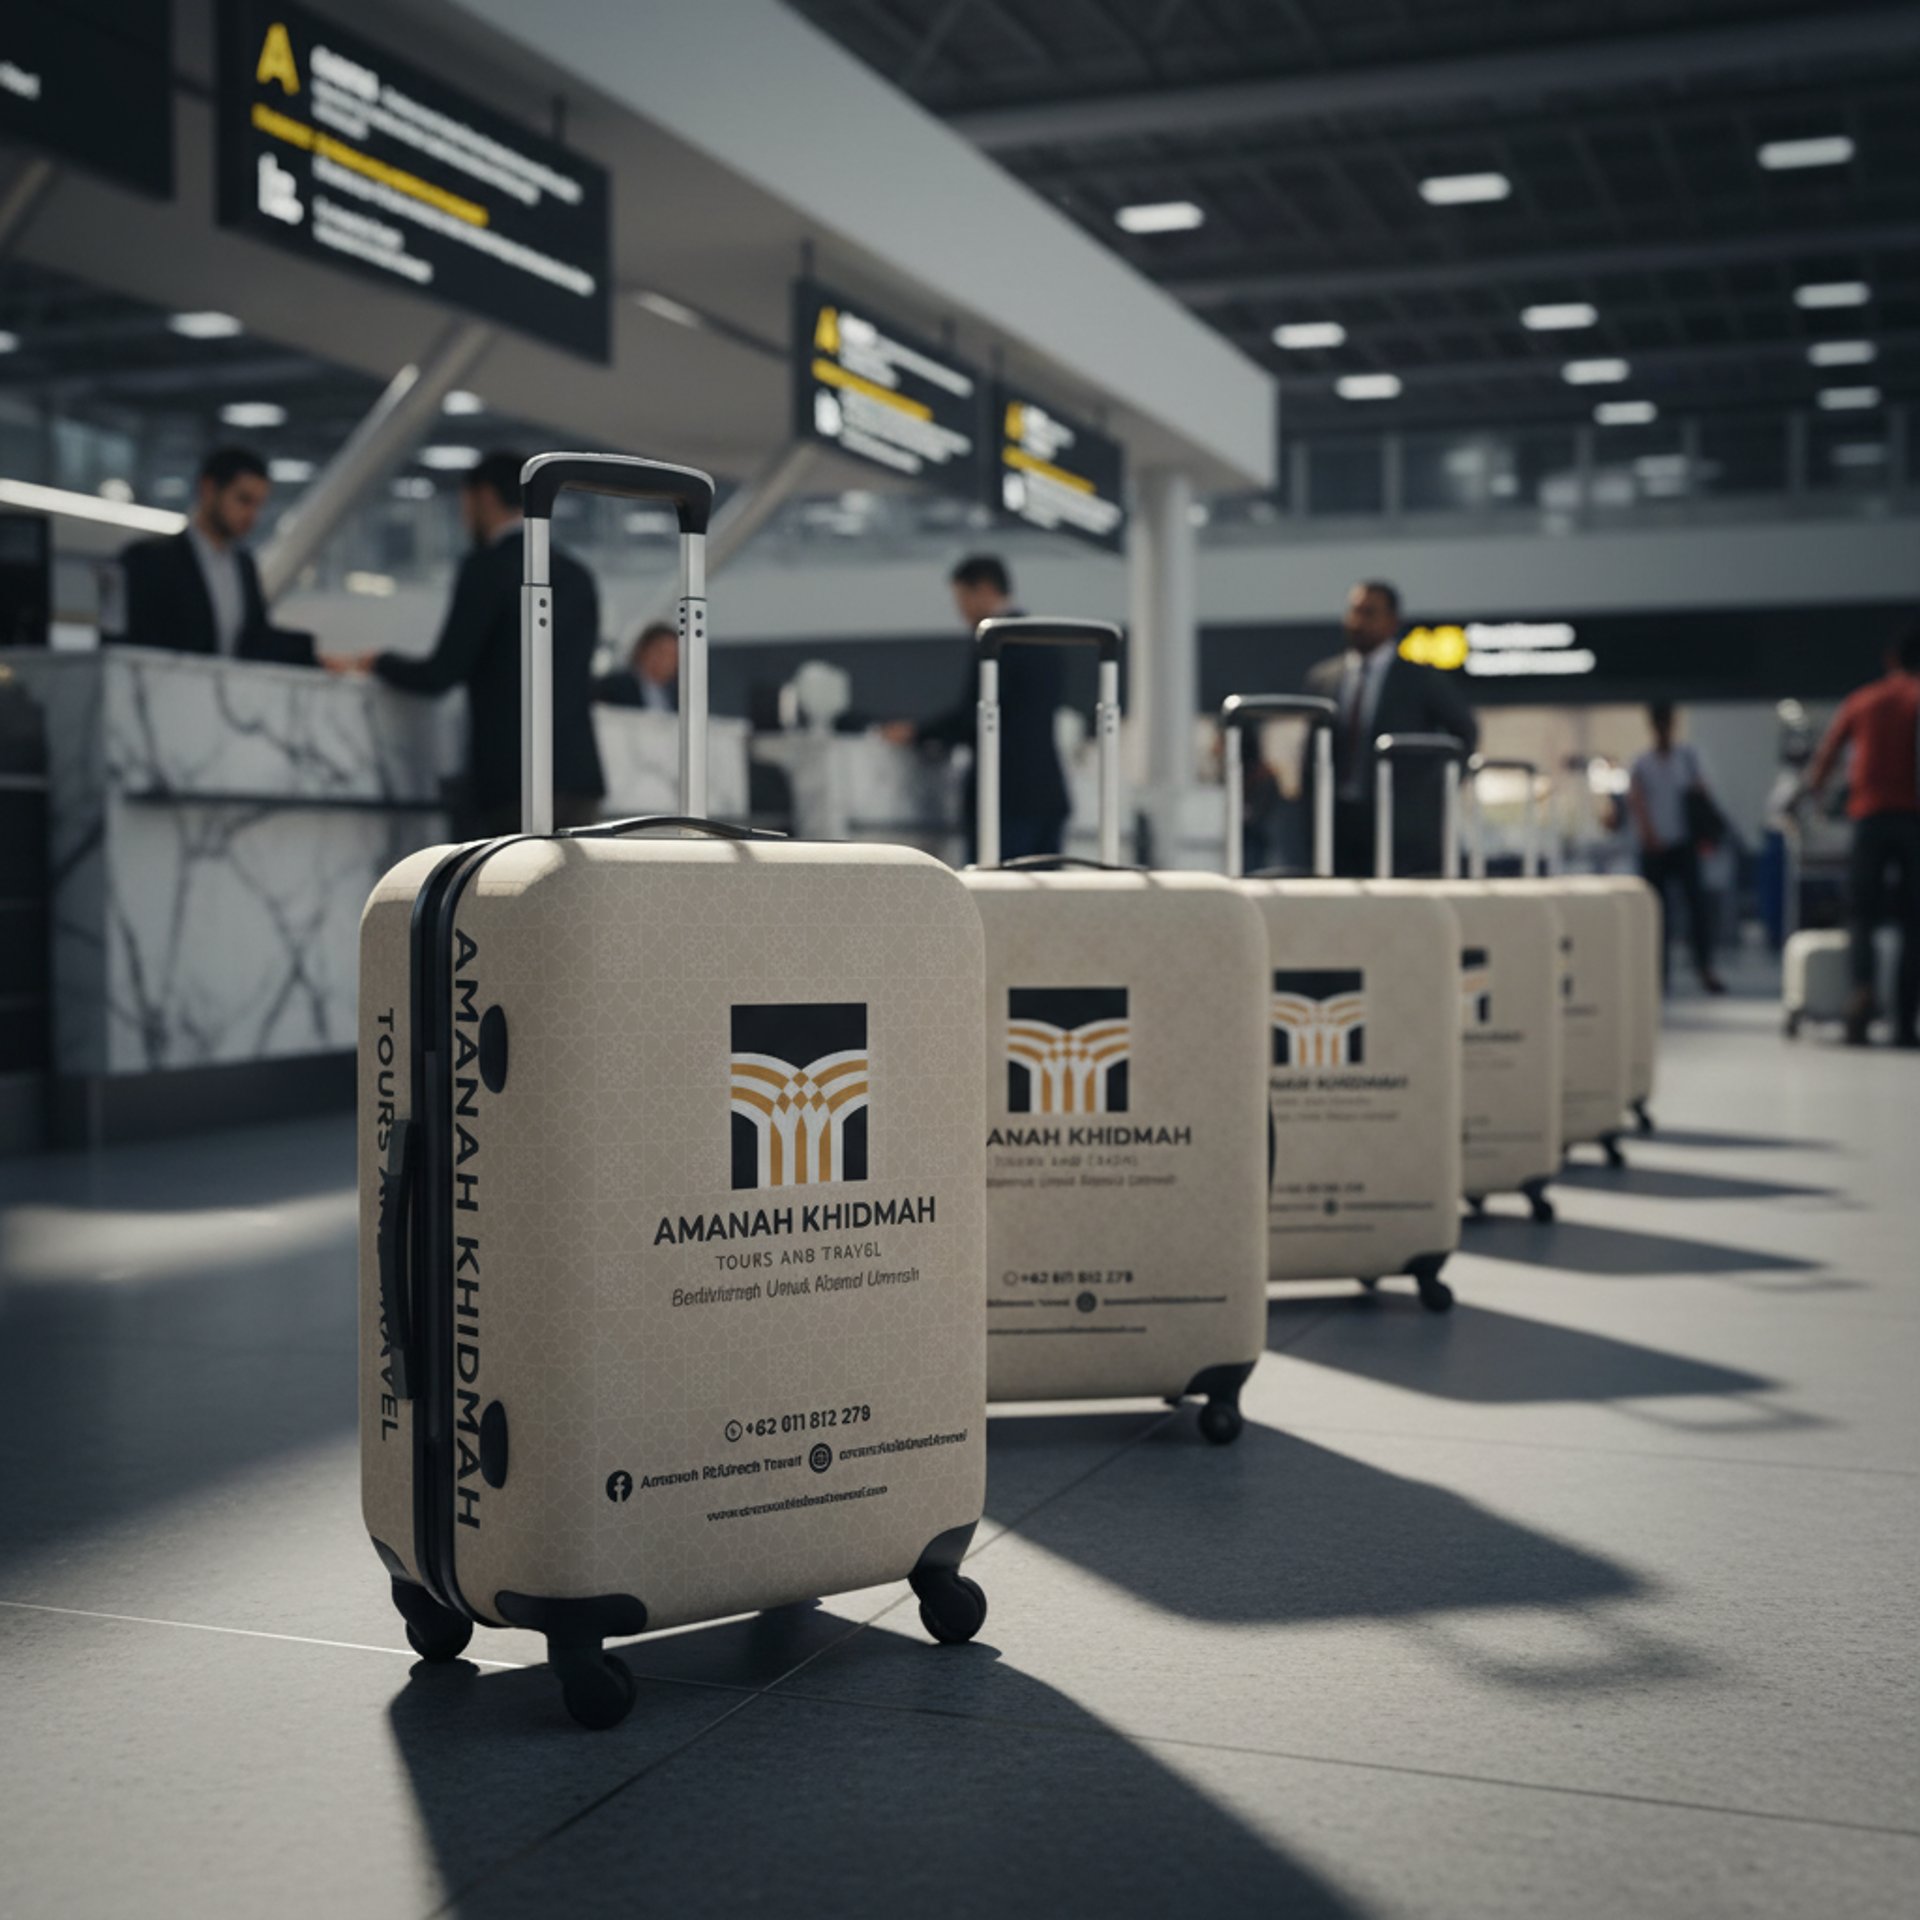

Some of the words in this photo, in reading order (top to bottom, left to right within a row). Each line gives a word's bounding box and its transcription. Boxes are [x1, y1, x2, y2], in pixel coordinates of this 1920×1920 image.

[257, 22, 299, 95] A
[377, 1007, 395, 1152] TOURS
[454, 927, 480, 1212] AMANAH
[986, 1127, 1060, 1146] ANAH
[1068, 1125, 1192, 1146] KHIDMAH
[653, 1206, 793, 1246] AMANAH
[801, 1196, 936, 1233] KHIDMAH
[715, 1251, 774, 1271] TOURS
[456, 1236, 481, 1529] KHIDMAH
[745, 1416, 777, 1437] +62
[809, 1408, 837, 1430] 812
